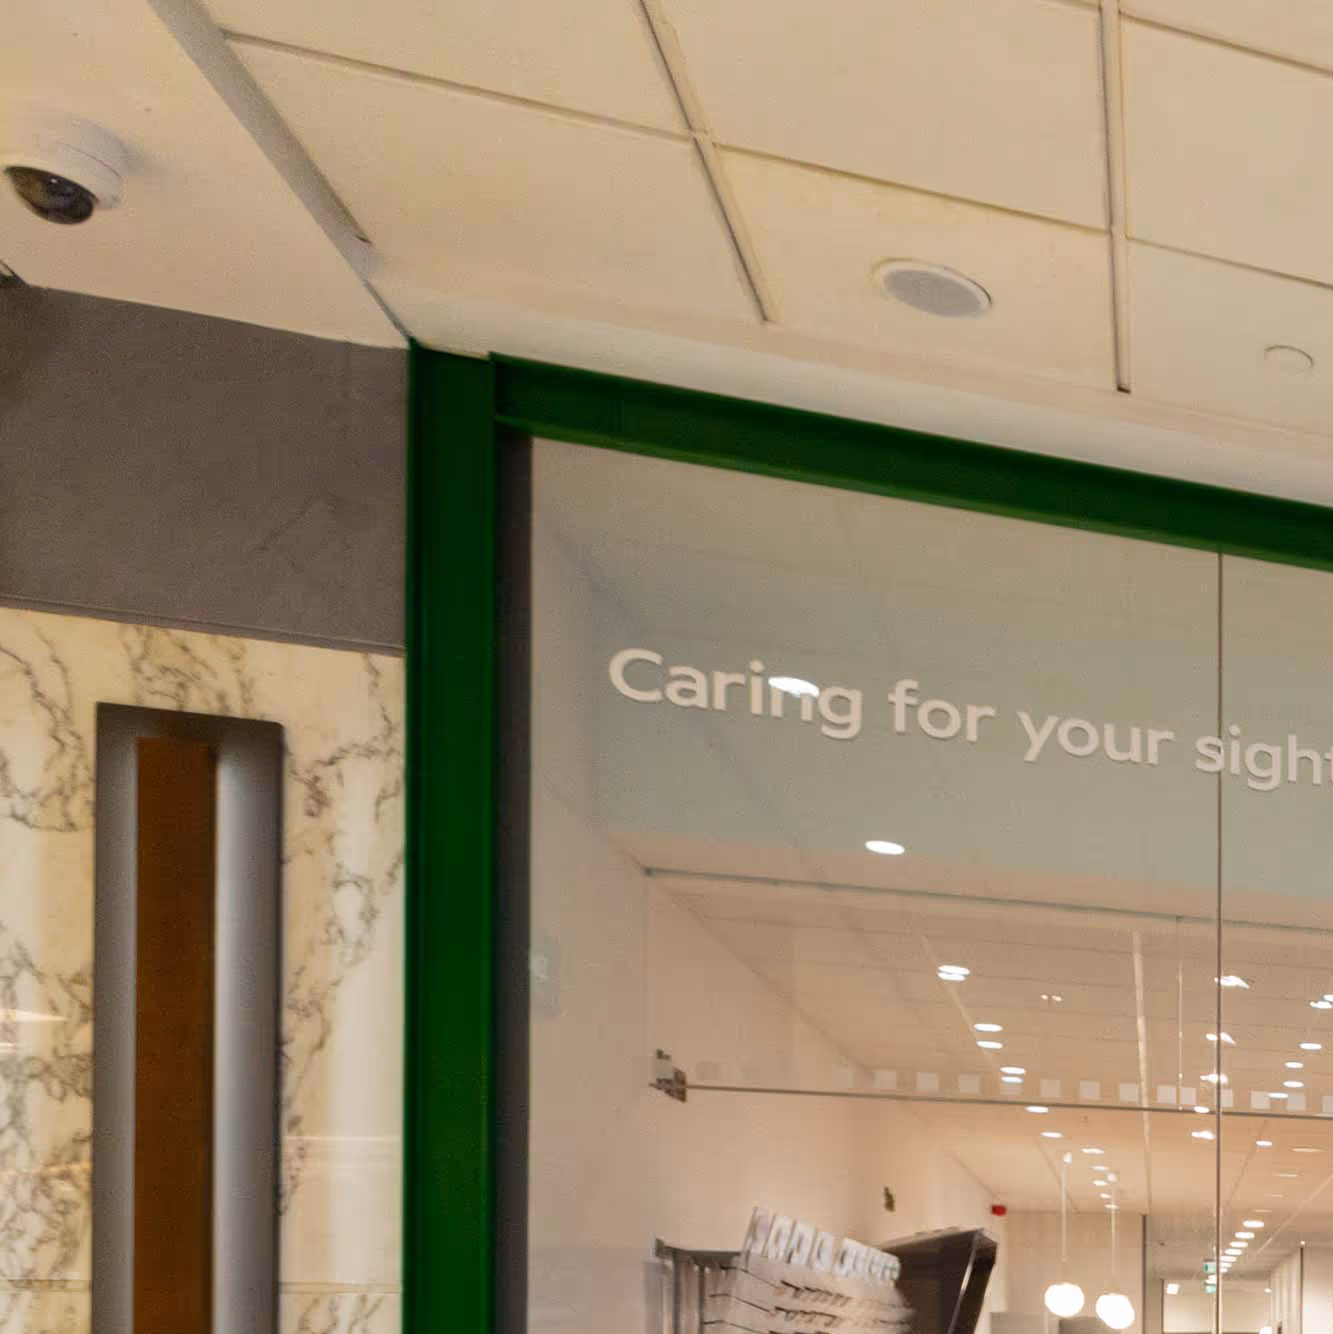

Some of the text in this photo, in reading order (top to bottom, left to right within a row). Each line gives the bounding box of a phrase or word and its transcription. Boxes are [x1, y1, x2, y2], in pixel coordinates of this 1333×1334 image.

[608, 648, 863, 740] Caring
[888, 679, 995, 741] for
[1016, 711, 1173, 765] your
